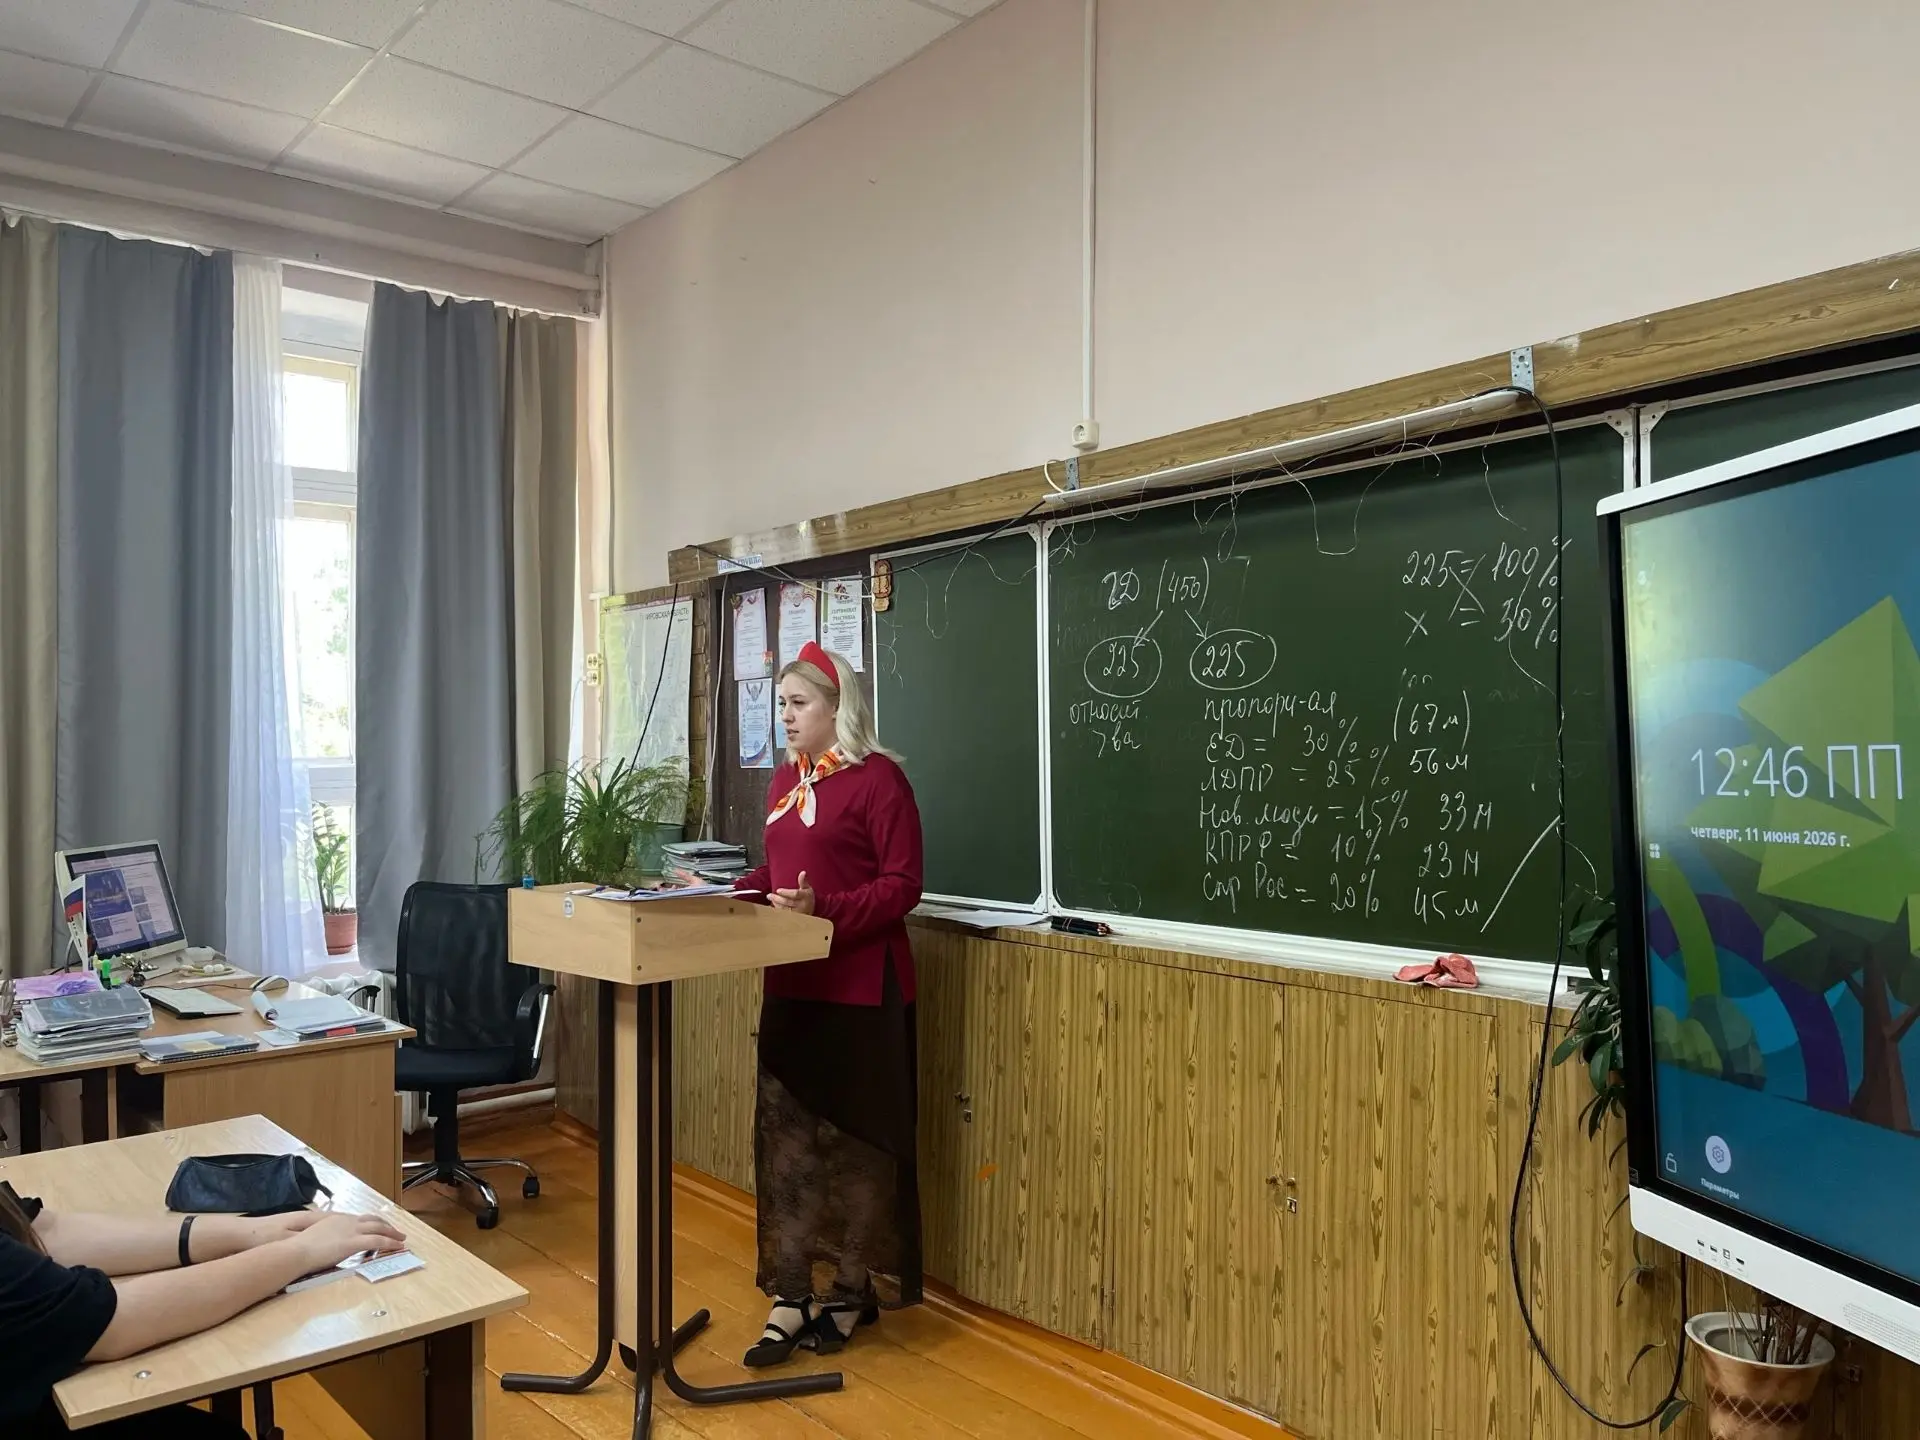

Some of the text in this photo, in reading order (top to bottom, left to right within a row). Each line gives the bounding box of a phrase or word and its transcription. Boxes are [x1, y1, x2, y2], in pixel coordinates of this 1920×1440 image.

[1156, 557, 1209, 614] (450)
[1402, 550, 1464, 588] 225
[1103, 641, 1146, 679] 225
[1202, 639, 1255, 679] 225
[1302, 716, 1358, 758] 30%
[1409, 747, 1439, 775] 56
[1691, 744, 1903, 800] 12:46 ПП
[1439, 791, 1467, 832] 33
[1691, 827, 1850, 847] четверг, 11 июня 2026 г.
[1418, 841, 1452, 878] 23
[1330, 868, 1380, 919] 20%
[1414, 886, 1449, 925] 45
[1700, 1177, 1740, 1200] Параметры
